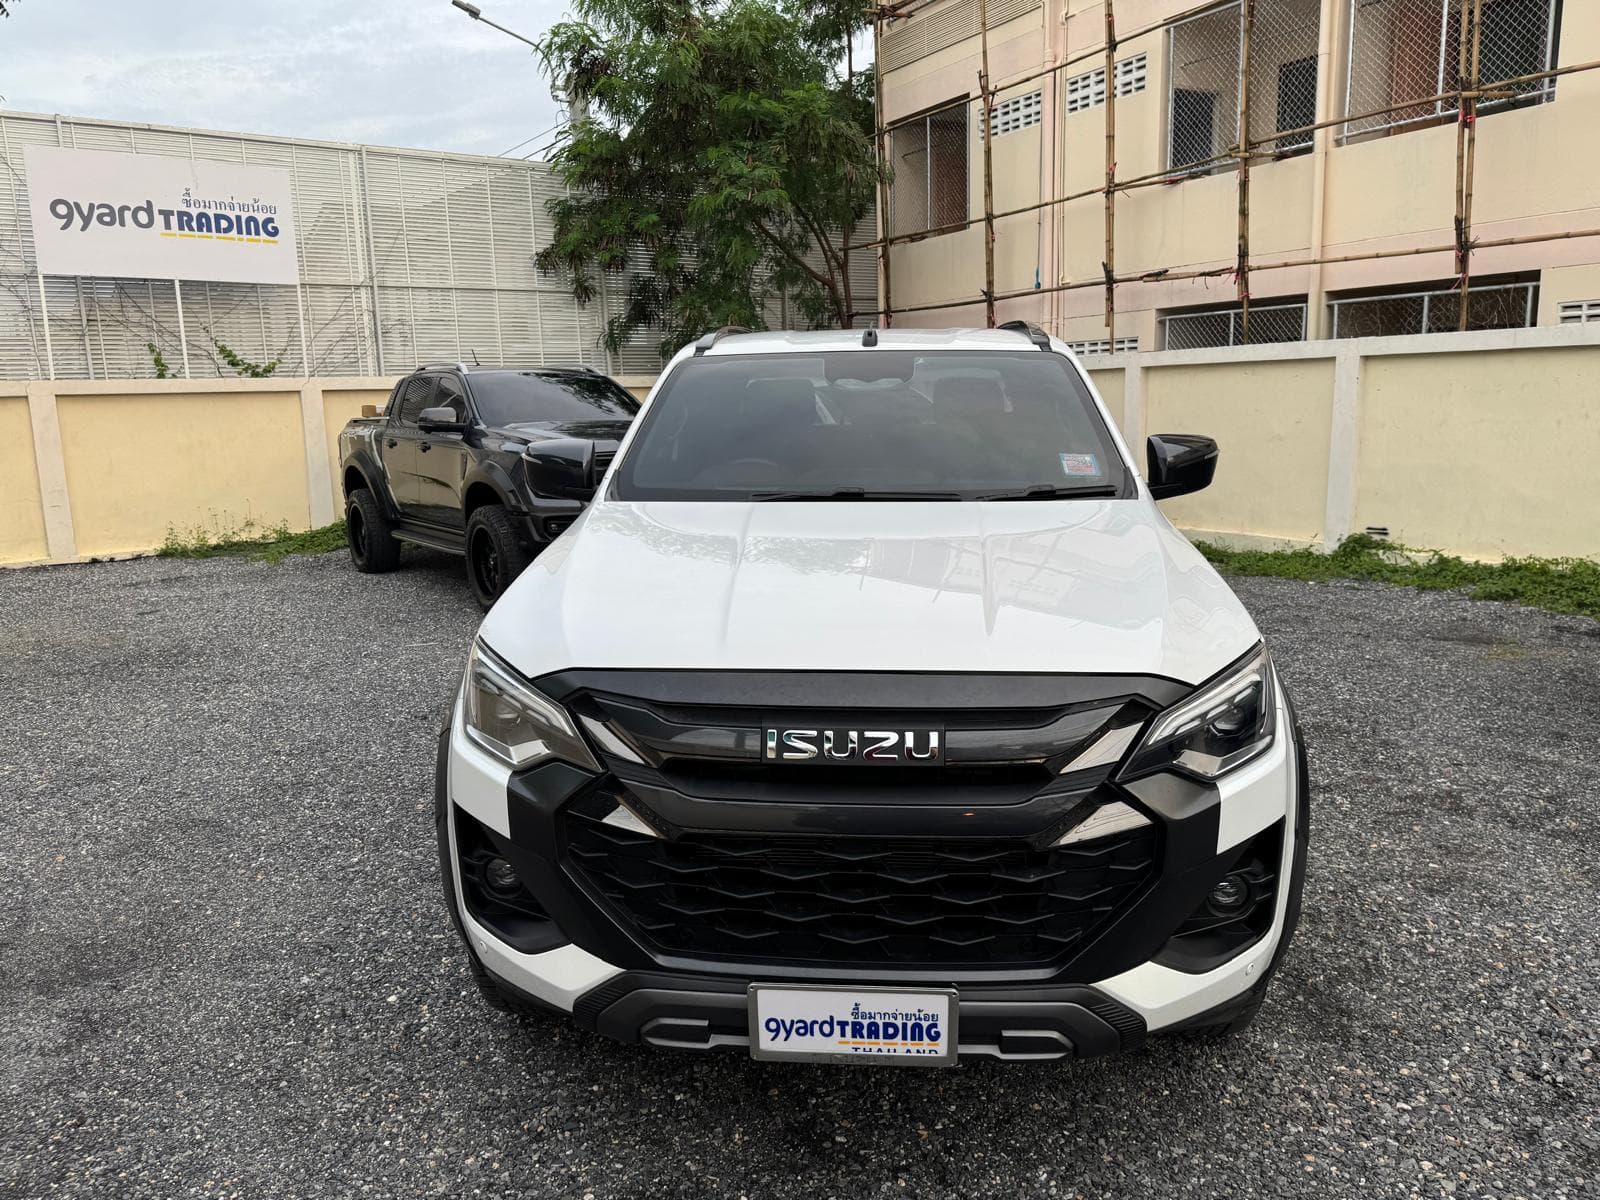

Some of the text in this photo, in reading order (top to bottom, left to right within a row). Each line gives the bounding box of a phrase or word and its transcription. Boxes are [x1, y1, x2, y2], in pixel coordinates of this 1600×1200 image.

[182, 187, 277, 215] ซื้อมากจ่ายน้อย
[766, 729, 939, 761] ISUZU
[851, 1002, 939, 1022] ซื้อมากจ่ายน้อย
